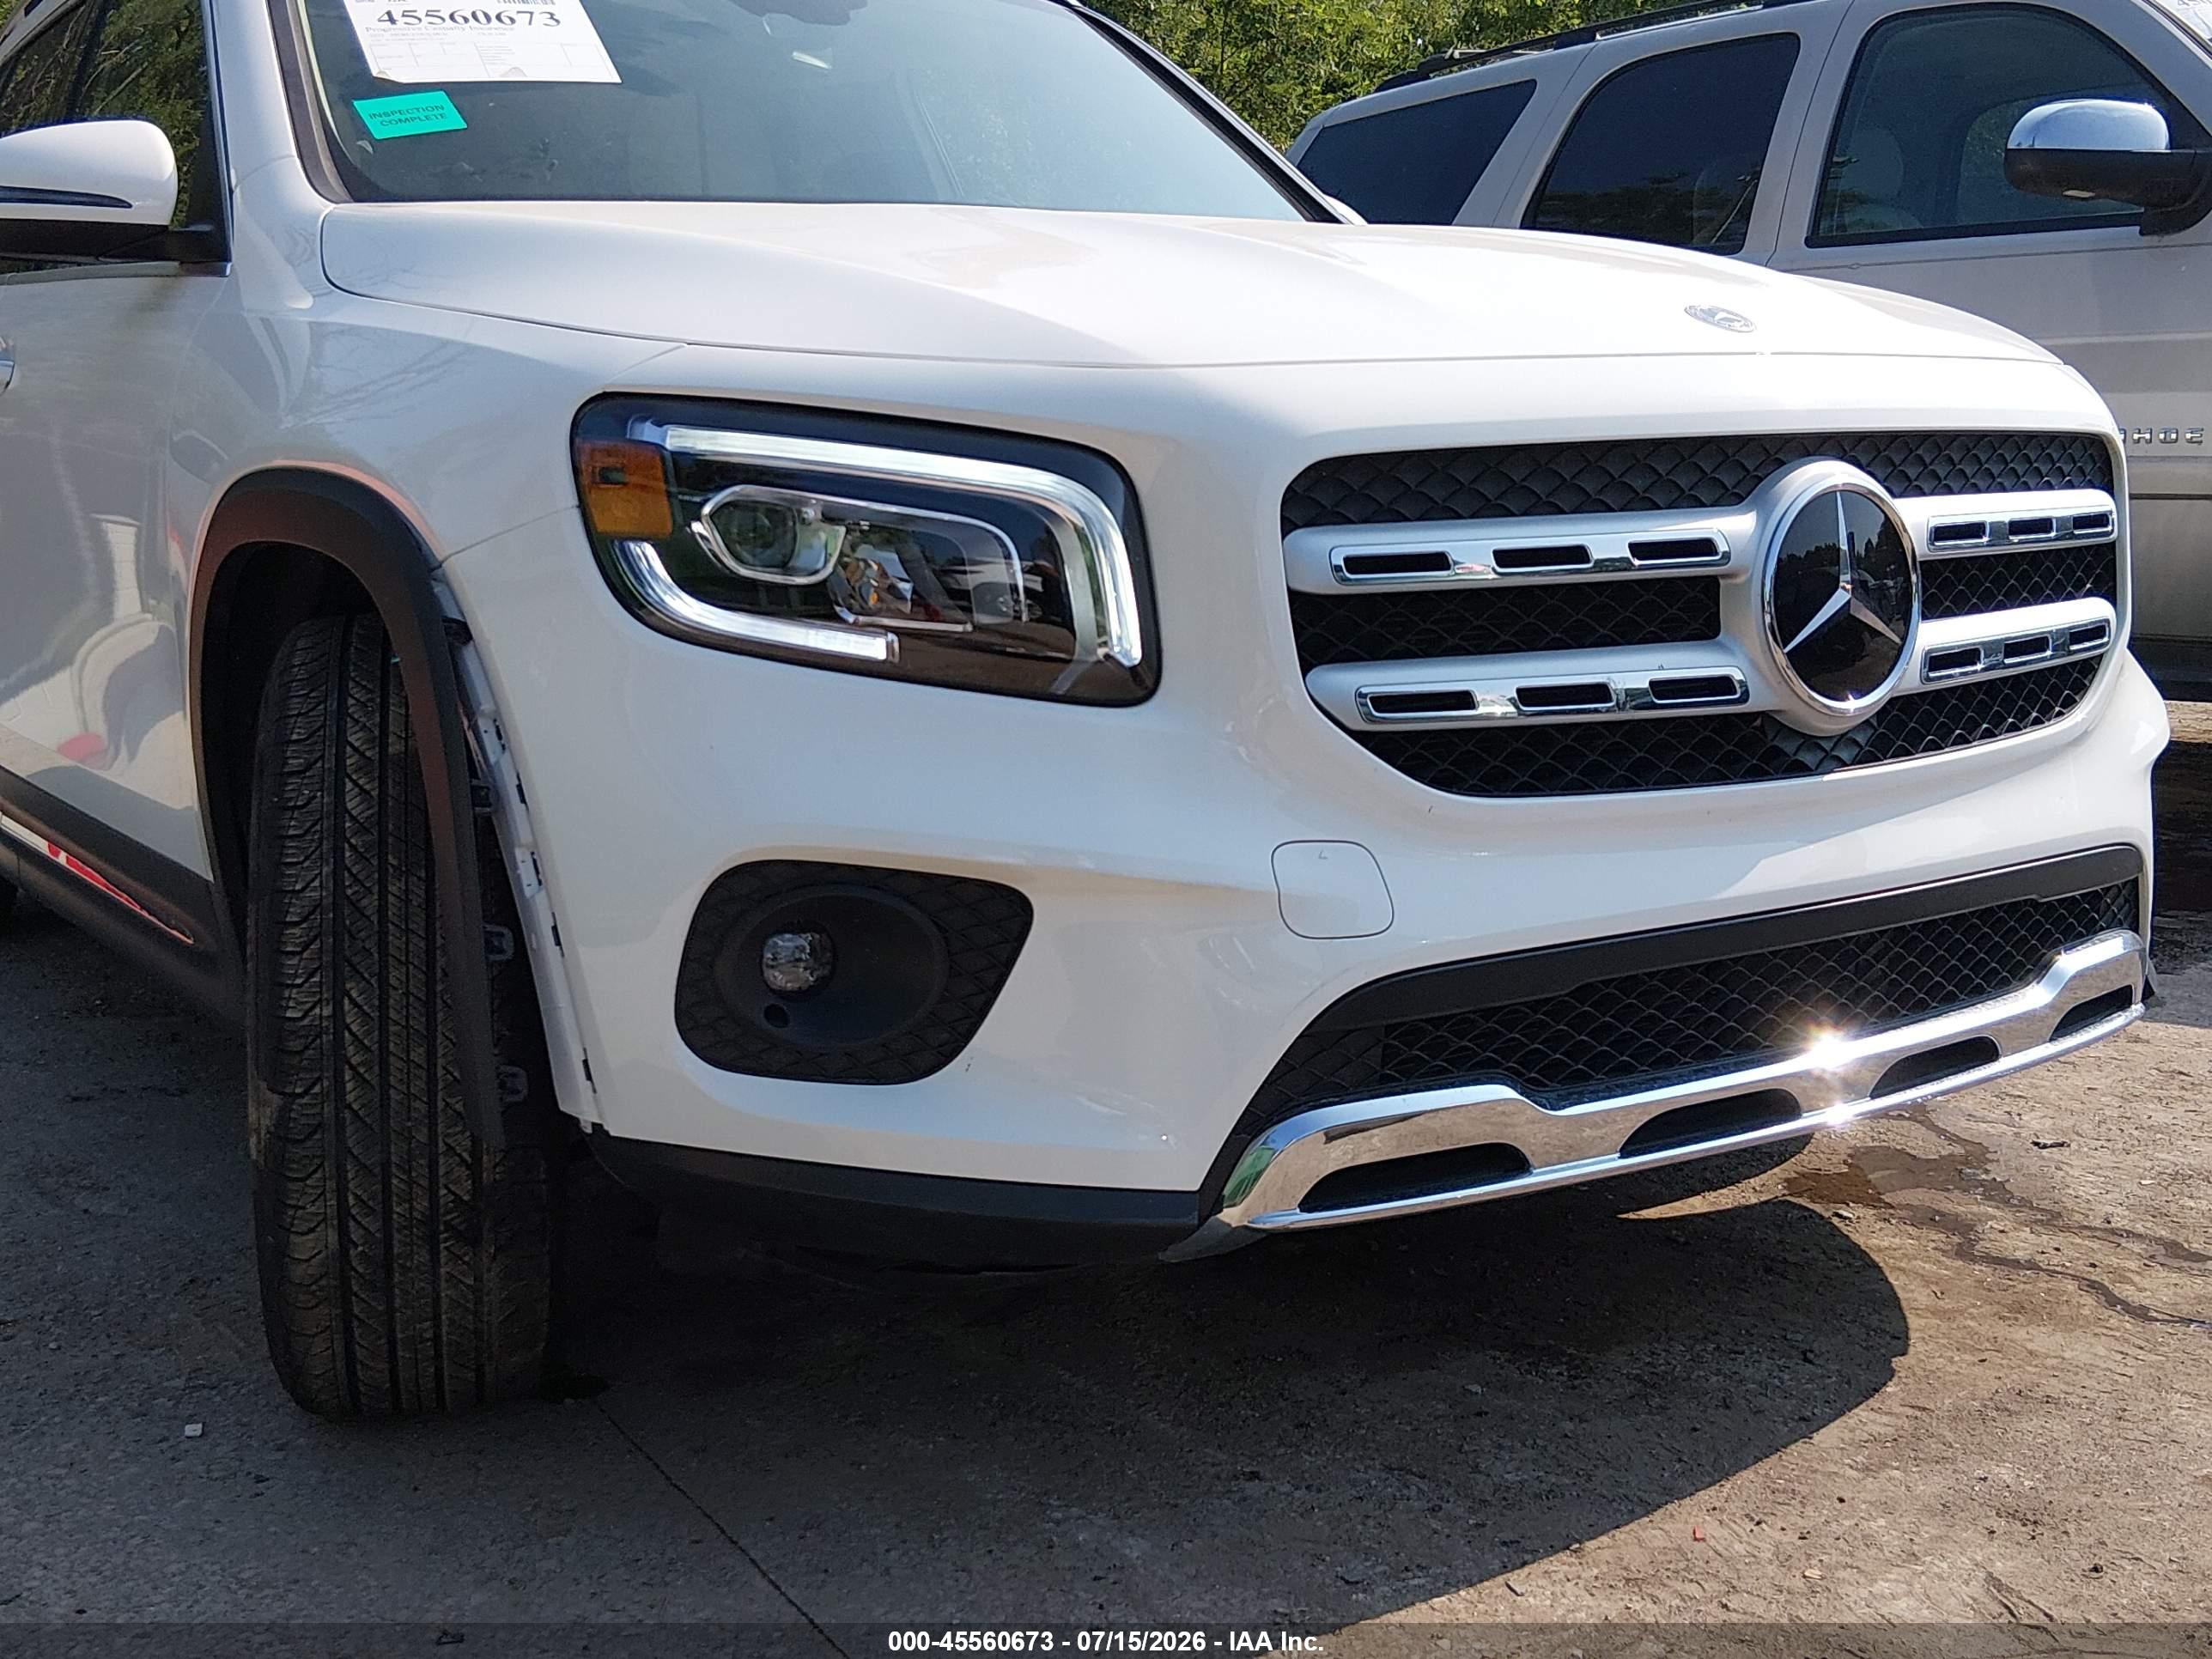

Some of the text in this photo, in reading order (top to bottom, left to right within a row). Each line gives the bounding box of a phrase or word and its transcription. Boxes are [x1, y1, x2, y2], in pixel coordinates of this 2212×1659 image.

[377, 9, 562, 27] 45560673
[368, 104, 445, 119] INSPECTION
[380, 112, 446, 126] COMPLETE
